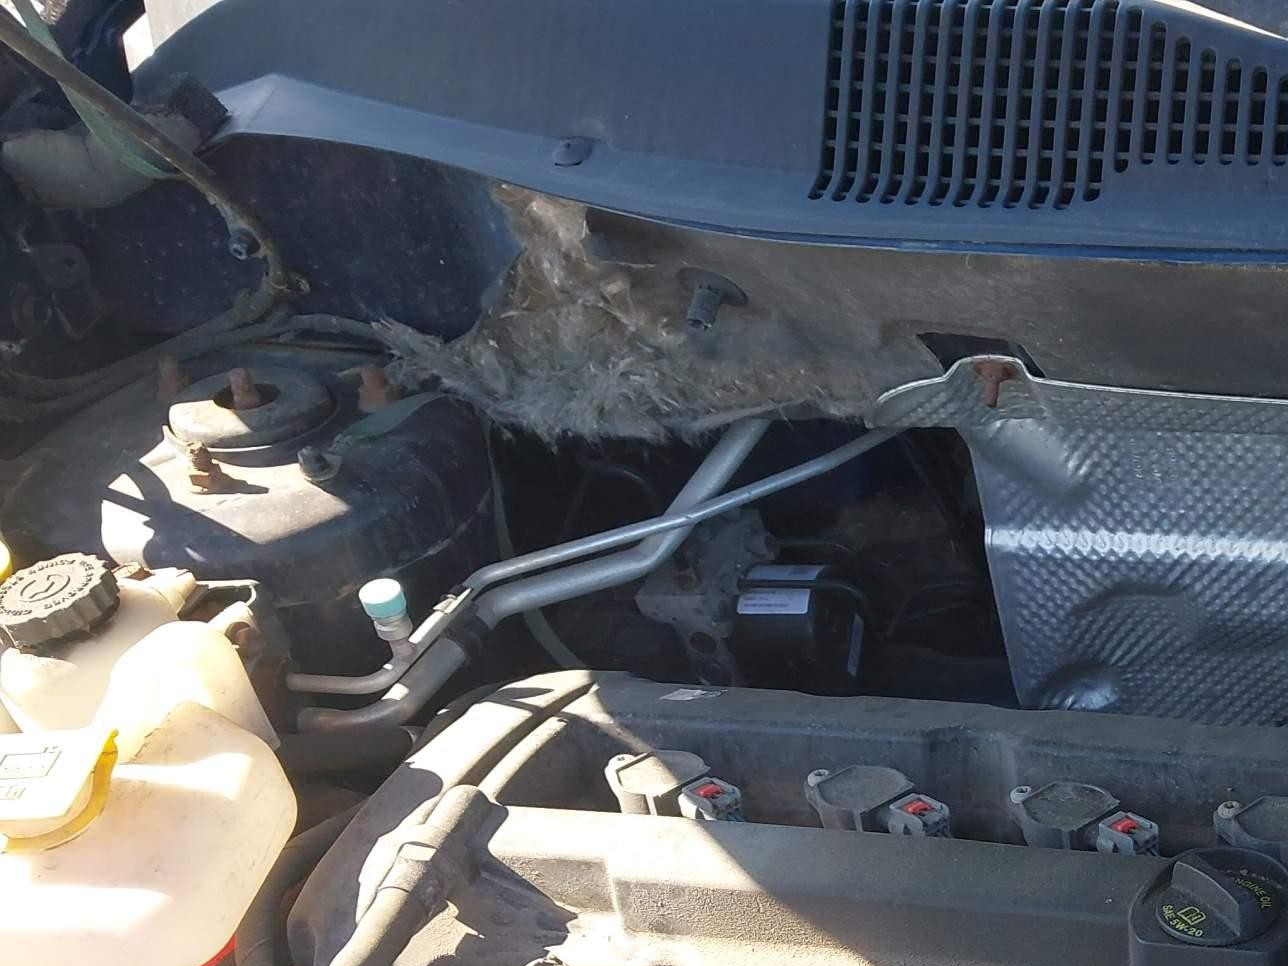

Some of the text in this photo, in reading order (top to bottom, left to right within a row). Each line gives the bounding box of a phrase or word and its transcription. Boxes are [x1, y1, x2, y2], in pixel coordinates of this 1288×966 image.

[1234, 878, 1273, 909] NGINE OIL
[1162, 904, 1204, 938] SAE 5W-20
